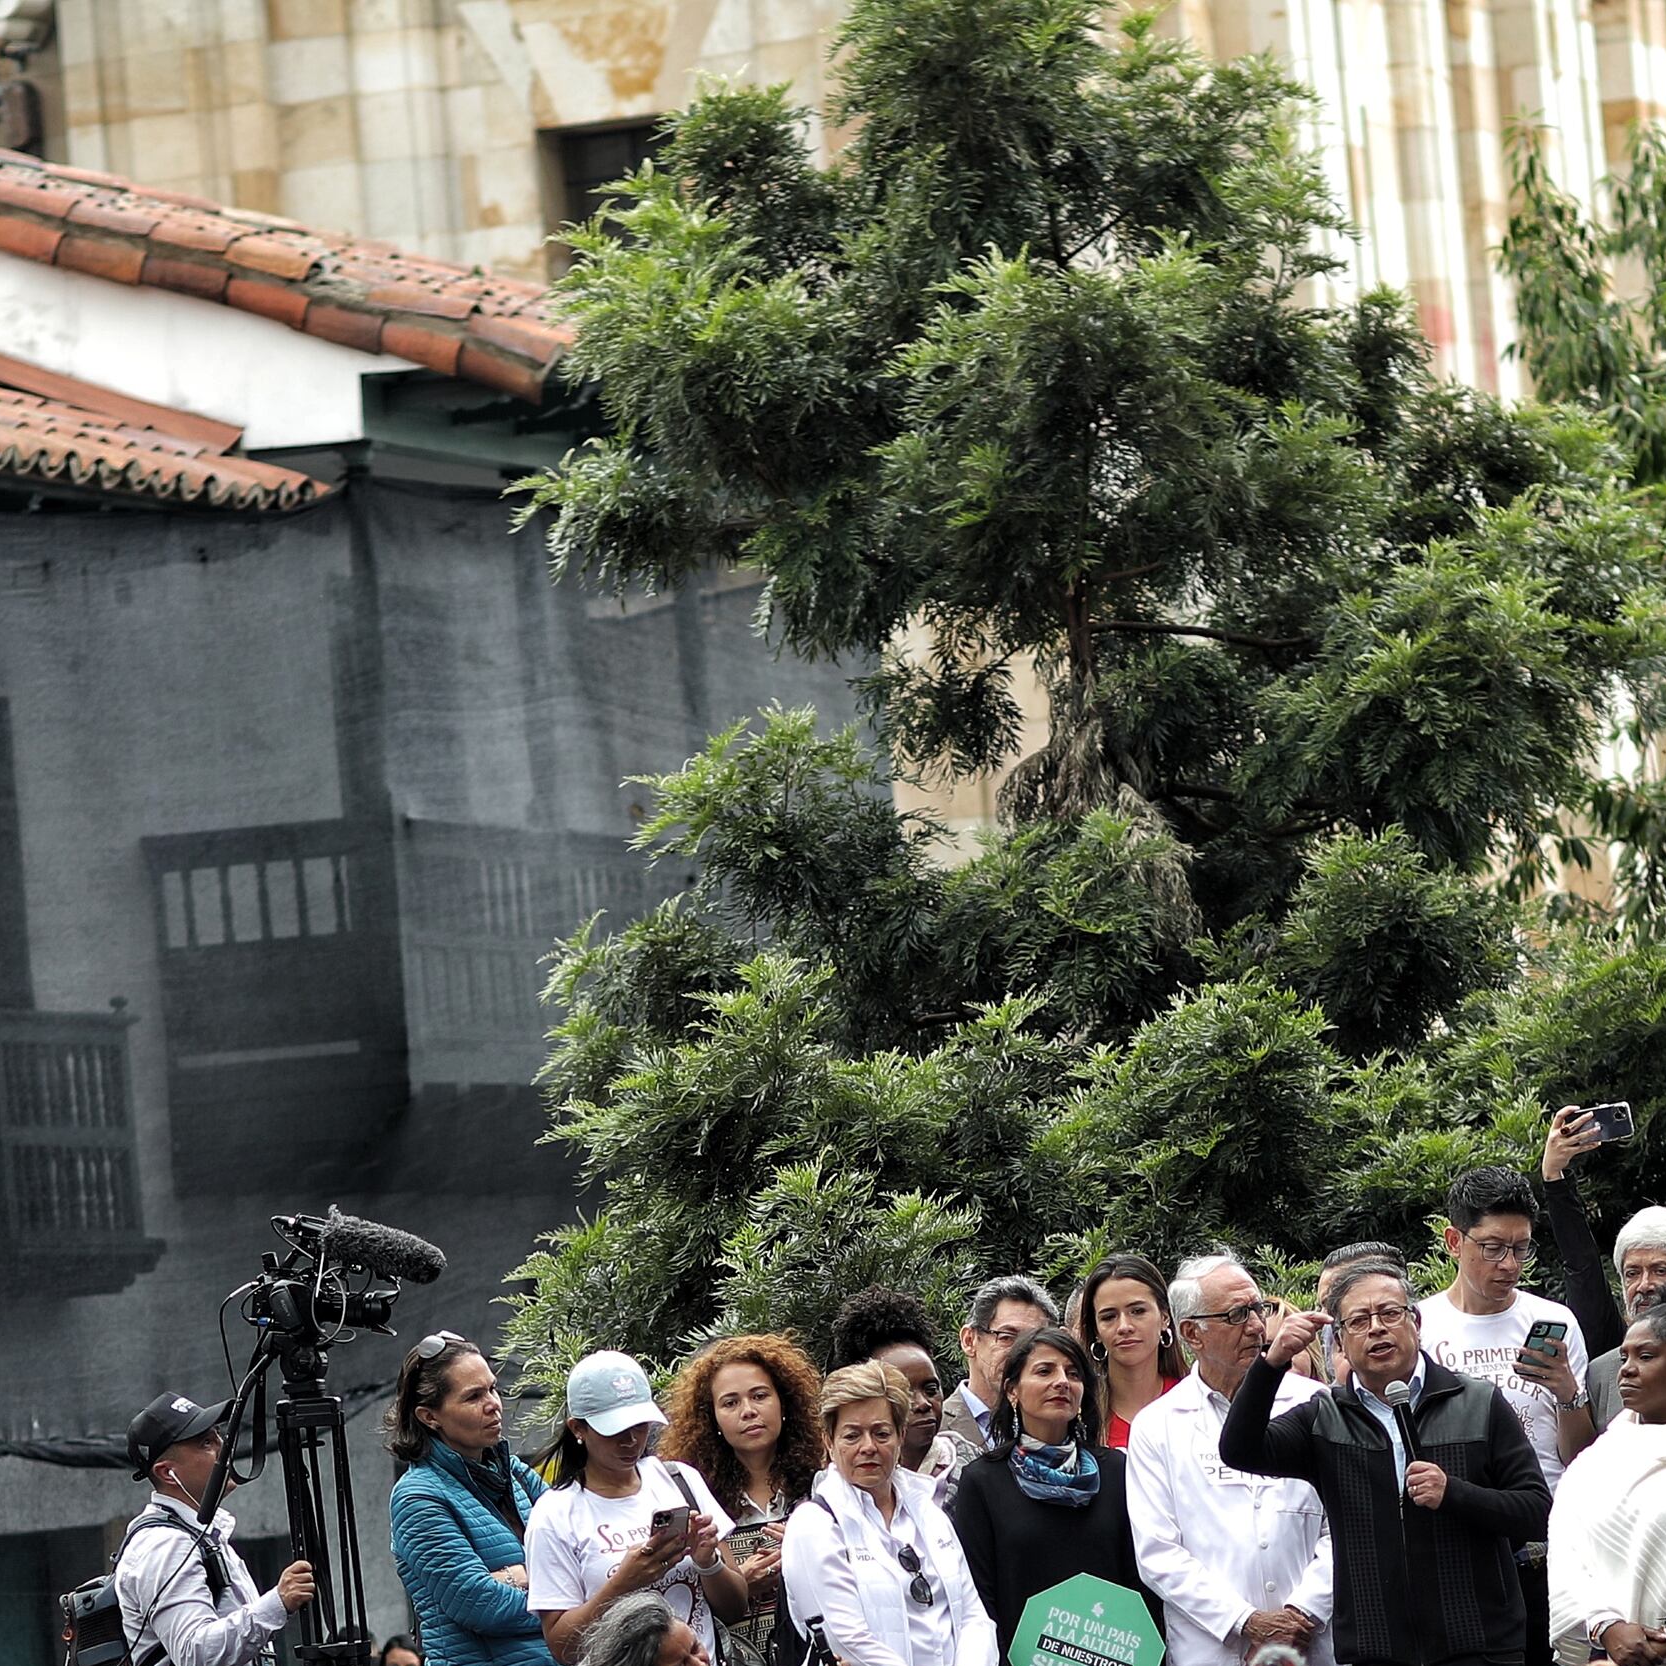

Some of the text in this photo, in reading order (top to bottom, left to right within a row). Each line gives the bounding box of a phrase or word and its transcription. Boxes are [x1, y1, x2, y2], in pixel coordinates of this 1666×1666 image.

[1463, 1347, 1520, 1366] PRIMER
[1042, 1621, 1135, 1662] A LA ALTURA
[1048, 1606, 1142, 1649] POR UN PAÍS
[1041, 1638, 1060, 1653] DE
